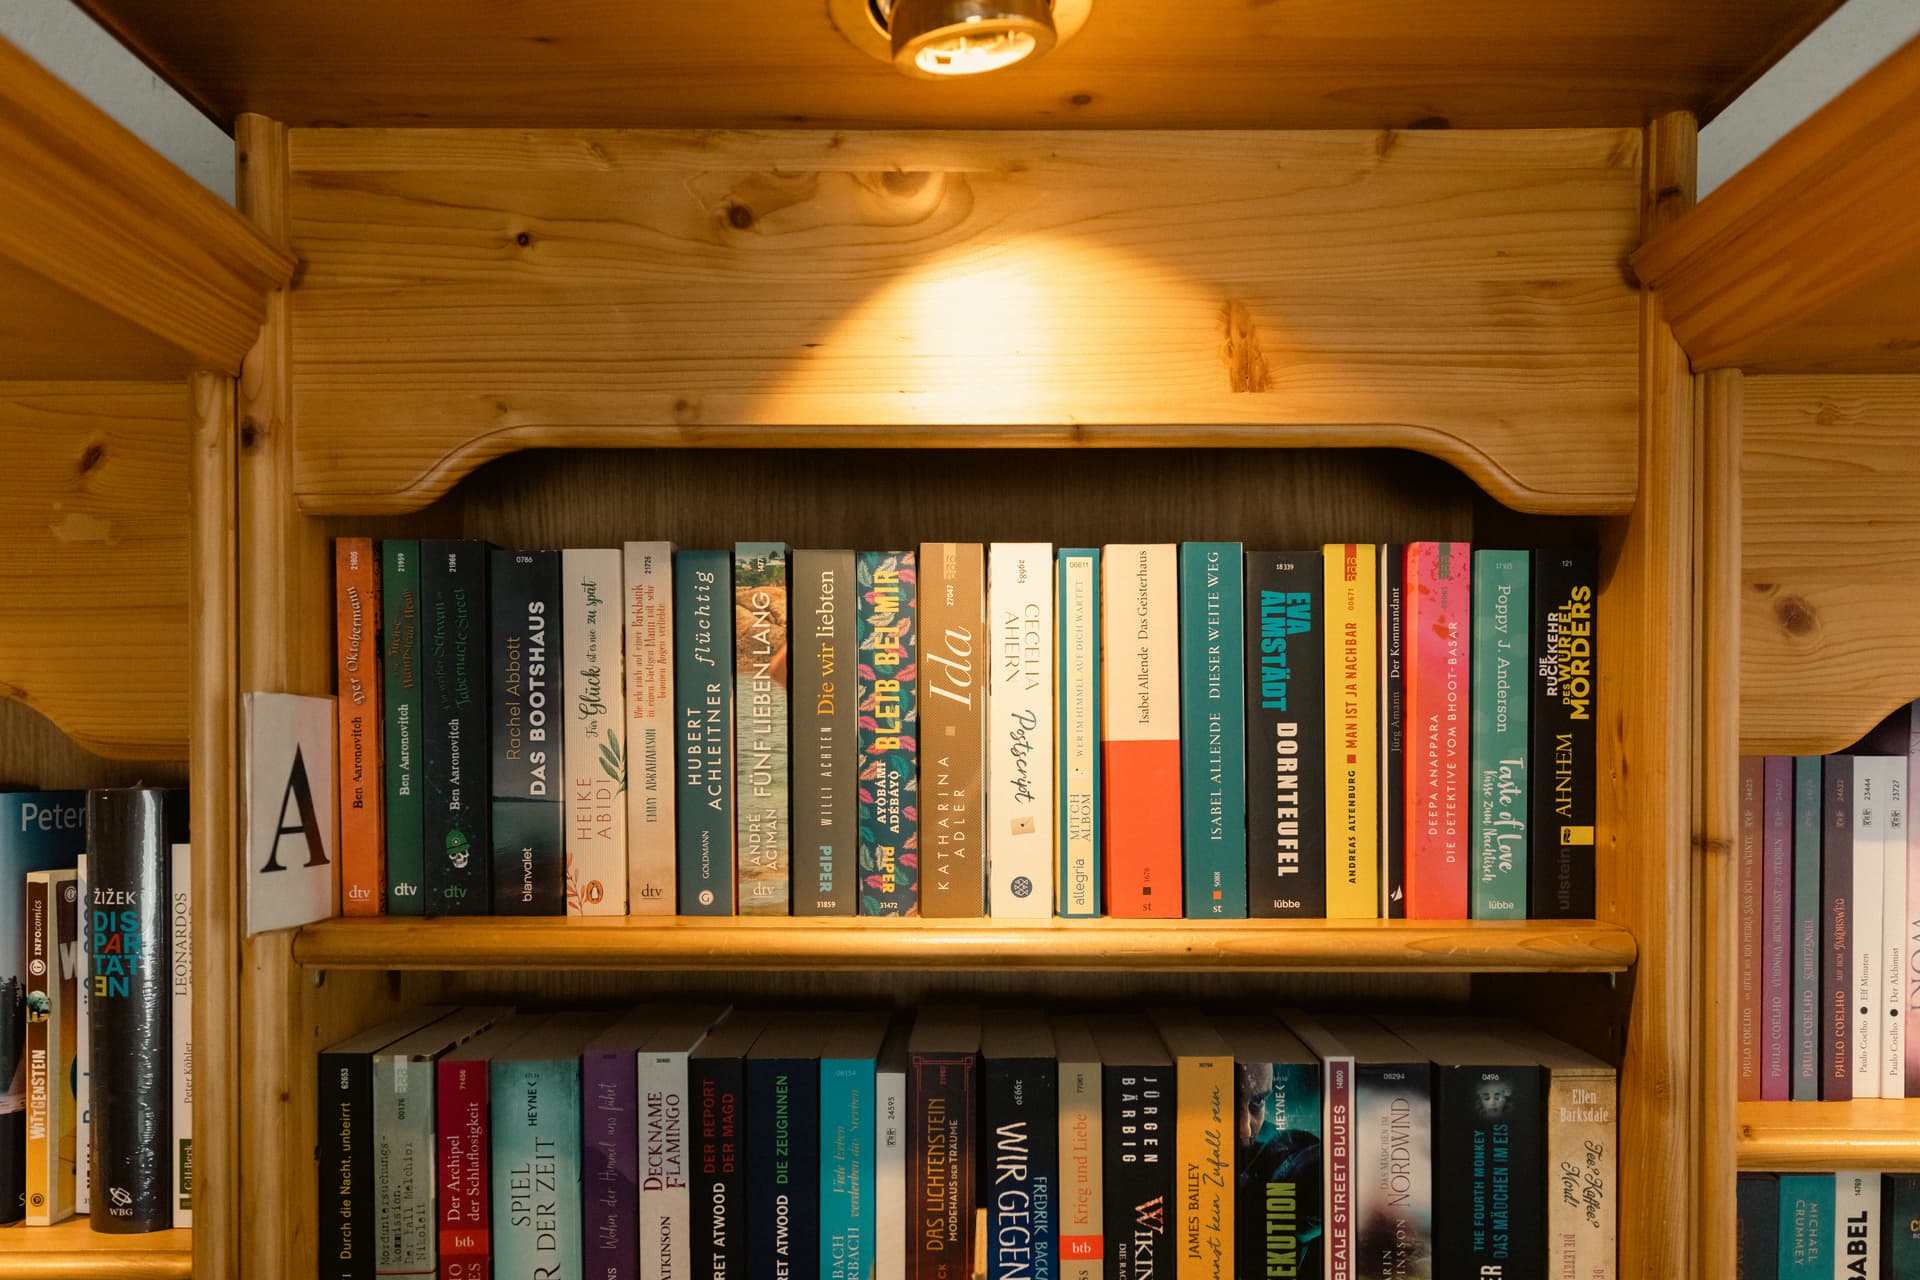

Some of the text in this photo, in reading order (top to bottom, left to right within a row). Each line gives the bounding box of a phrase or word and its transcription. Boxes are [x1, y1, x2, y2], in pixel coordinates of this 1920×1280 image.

[694, 571, 716, 667] flüchtig
[1136, 550, 1149, 640] Das Geisterhaus
[1206, 550, 1221, 699] DIESER WEITE WEG
[1288, 592, 1312, 634] EVA
[1389, 587, 1400, 678] Der Kommandant
[1497, 584, 1511, 633] Poppy
[346, 585, 365, 706] Der Oktobermann
[578, 576, 606, 719] Glück spät
[815, 570, 835, 716] Die wir liebten
[875, 571, 901, 750] BLEIB BEI MIR
[927, 626, 972, 710] Ida
[1004, 611, 1021, 682] AHERN
[1025, 603, 1040, 690] CECELIA
[1137, 646, 1150, 724] Isabel Allende
[1260, 590, 1290, 712] ALMSTÄDT
[1344, 622, 1358, 749] MAN IST JA NACHBAR
[1497, 642, 1511, 652] J.
[1539, 657, 1548, 677] DIE
[1546, 612, 1558, 696] RÜCKKEHR
[1557, 600, 1572, 705] DES WÜRFEL
[1568, 585, 1590, 720] MÖRDERS
[505, 636, 521, 760] Rachel Abbott
[529, 601, 547, 795] DAS BOOTSHAUS
[751, 591, 772, 797] FÜNF LIEBEN LANG
[1496, 657, 1511, 732] Anderson
[398, 704, 410, 796] Ben Aaronovitch
[448, 718, 460, 810] Ben Aaronovitch
[645, 728, 657, 823] EMMY ABRAHAMSON
[687, 706, 702, 785] HUBERT
[707, 682, 722, 810] ACHLEITNER
[820, 727, 833, 826] WILLI ACHTEN
[1010, 709, 1037, 804] Postscript
[1208, 712, 1222, 840] ISABEL ALLENDE
[1428, 714, 1438, 835] DEEPA ANAPPARA
[1446, 621, 1459, 863] DIE DETEKTIVE VOM BHOOT-BASAR
[1555, 733, 1572, 818] AHNHEM
[260, 741, 330, 874] A
[576, 778, 593, 840] HEIKE
[596, 778, 612, 839] ABIDI
[937, 755, 950, 890] KATHARINA
[953, 788, 966, 858] ADLER
[1276, 722, 1299, 876] DORNTEUFEL
[1347, 770, 1356, 884] ANDREAS ALTENBURG
[1494, 757, 1525, 873] Taste of Love
[1862, 778, 1872, 801] 23444
[1891, 779, 1900, 801] 23727
[521, 847, 533, 902] blanvalet
[702, 830, 710, 879] GOLDMANN
[747, 813, 761, 866] ANDRÉ
[765, 808, 778, 871] ACIMAN
[819, 845, 833, 892] PIPER
[882, 846, 896, 893] PIPER
[1073, 858, 1089, 906] allegria
[32, 899, 44, 956] INFOcomics
[93, 910, 139, 931] DIS
[94, 889, 137, 905] ŽIŽEK
[92, 952, 139, 975] TÄT
[93, 933, 141, 955] PAR
[175, 892, 187, 996] LEONARDOS
[1860, 953, 1869, 1001] Elf Minuten
[1890, 948, 1900, 1003] Der Alchimist
[1834, 990, 1846, 1078] PAULO COELHO
[1858, 1020, 1868, 1074] Paulo Coelho
[1890, 1022, 1899, 1076] Paulo Coelho
[528, 1089, 537, 1126] HEYNE
[643, 1091, 663, 1192] DECKNAME
[666, 1093, 686, 1189] FLAMINGO
[703, 1079, 716, 1173] DER REPORT
[722, 1093, 735, 1173] DER MAGD
[887, 1096, 895, 1120] 24595
[948, 1119, 958, 1162] TRÄUME
[1122, 1077, 1138, 1162] BÄRBIG
[1143, 1077, 1161, 1162] JÜRGEN
[1333, 1104, 1346, 1157] BLUES
[340, 1102, 352, 1259] Durch die Nacht, unbeirrt
[447, 1135, 464, 1221] Der Archipel
[467, 1102, 482, 1221] der Schlaflosigkeit
[511, 1162, 531, 1227] SPIEL
[535, 1136, 556, 1251] DER ZEIT
[926, 1098, 946, 1251] DAS LICHTENSTEIN
[995, 1122, 1029, 1185] WIR
[1073, 1113, 1092, 1225] Krieg und Liebe
[1335, 1164, 1347, 1223] STREET
[1388, 1097, 1411, 1207] NORDWIND
[1473, 1129, 1485, 1252] THE FOURTH MONKEY
[109, 1208, 133, 1216] WBG
[713, 1182, 725, 1247] ATWOOD
[948, 1180, 958, 1241] MODEHAUS
[1033, 1176, 1048, 1234] FREDRIK
[1188, 1163, 1201, 1259] JAMES BAILEY
[1794, 1199, 1806, 1266] CRUMMEY
[1808, 1202, 1819, 1263] MICHAEL
